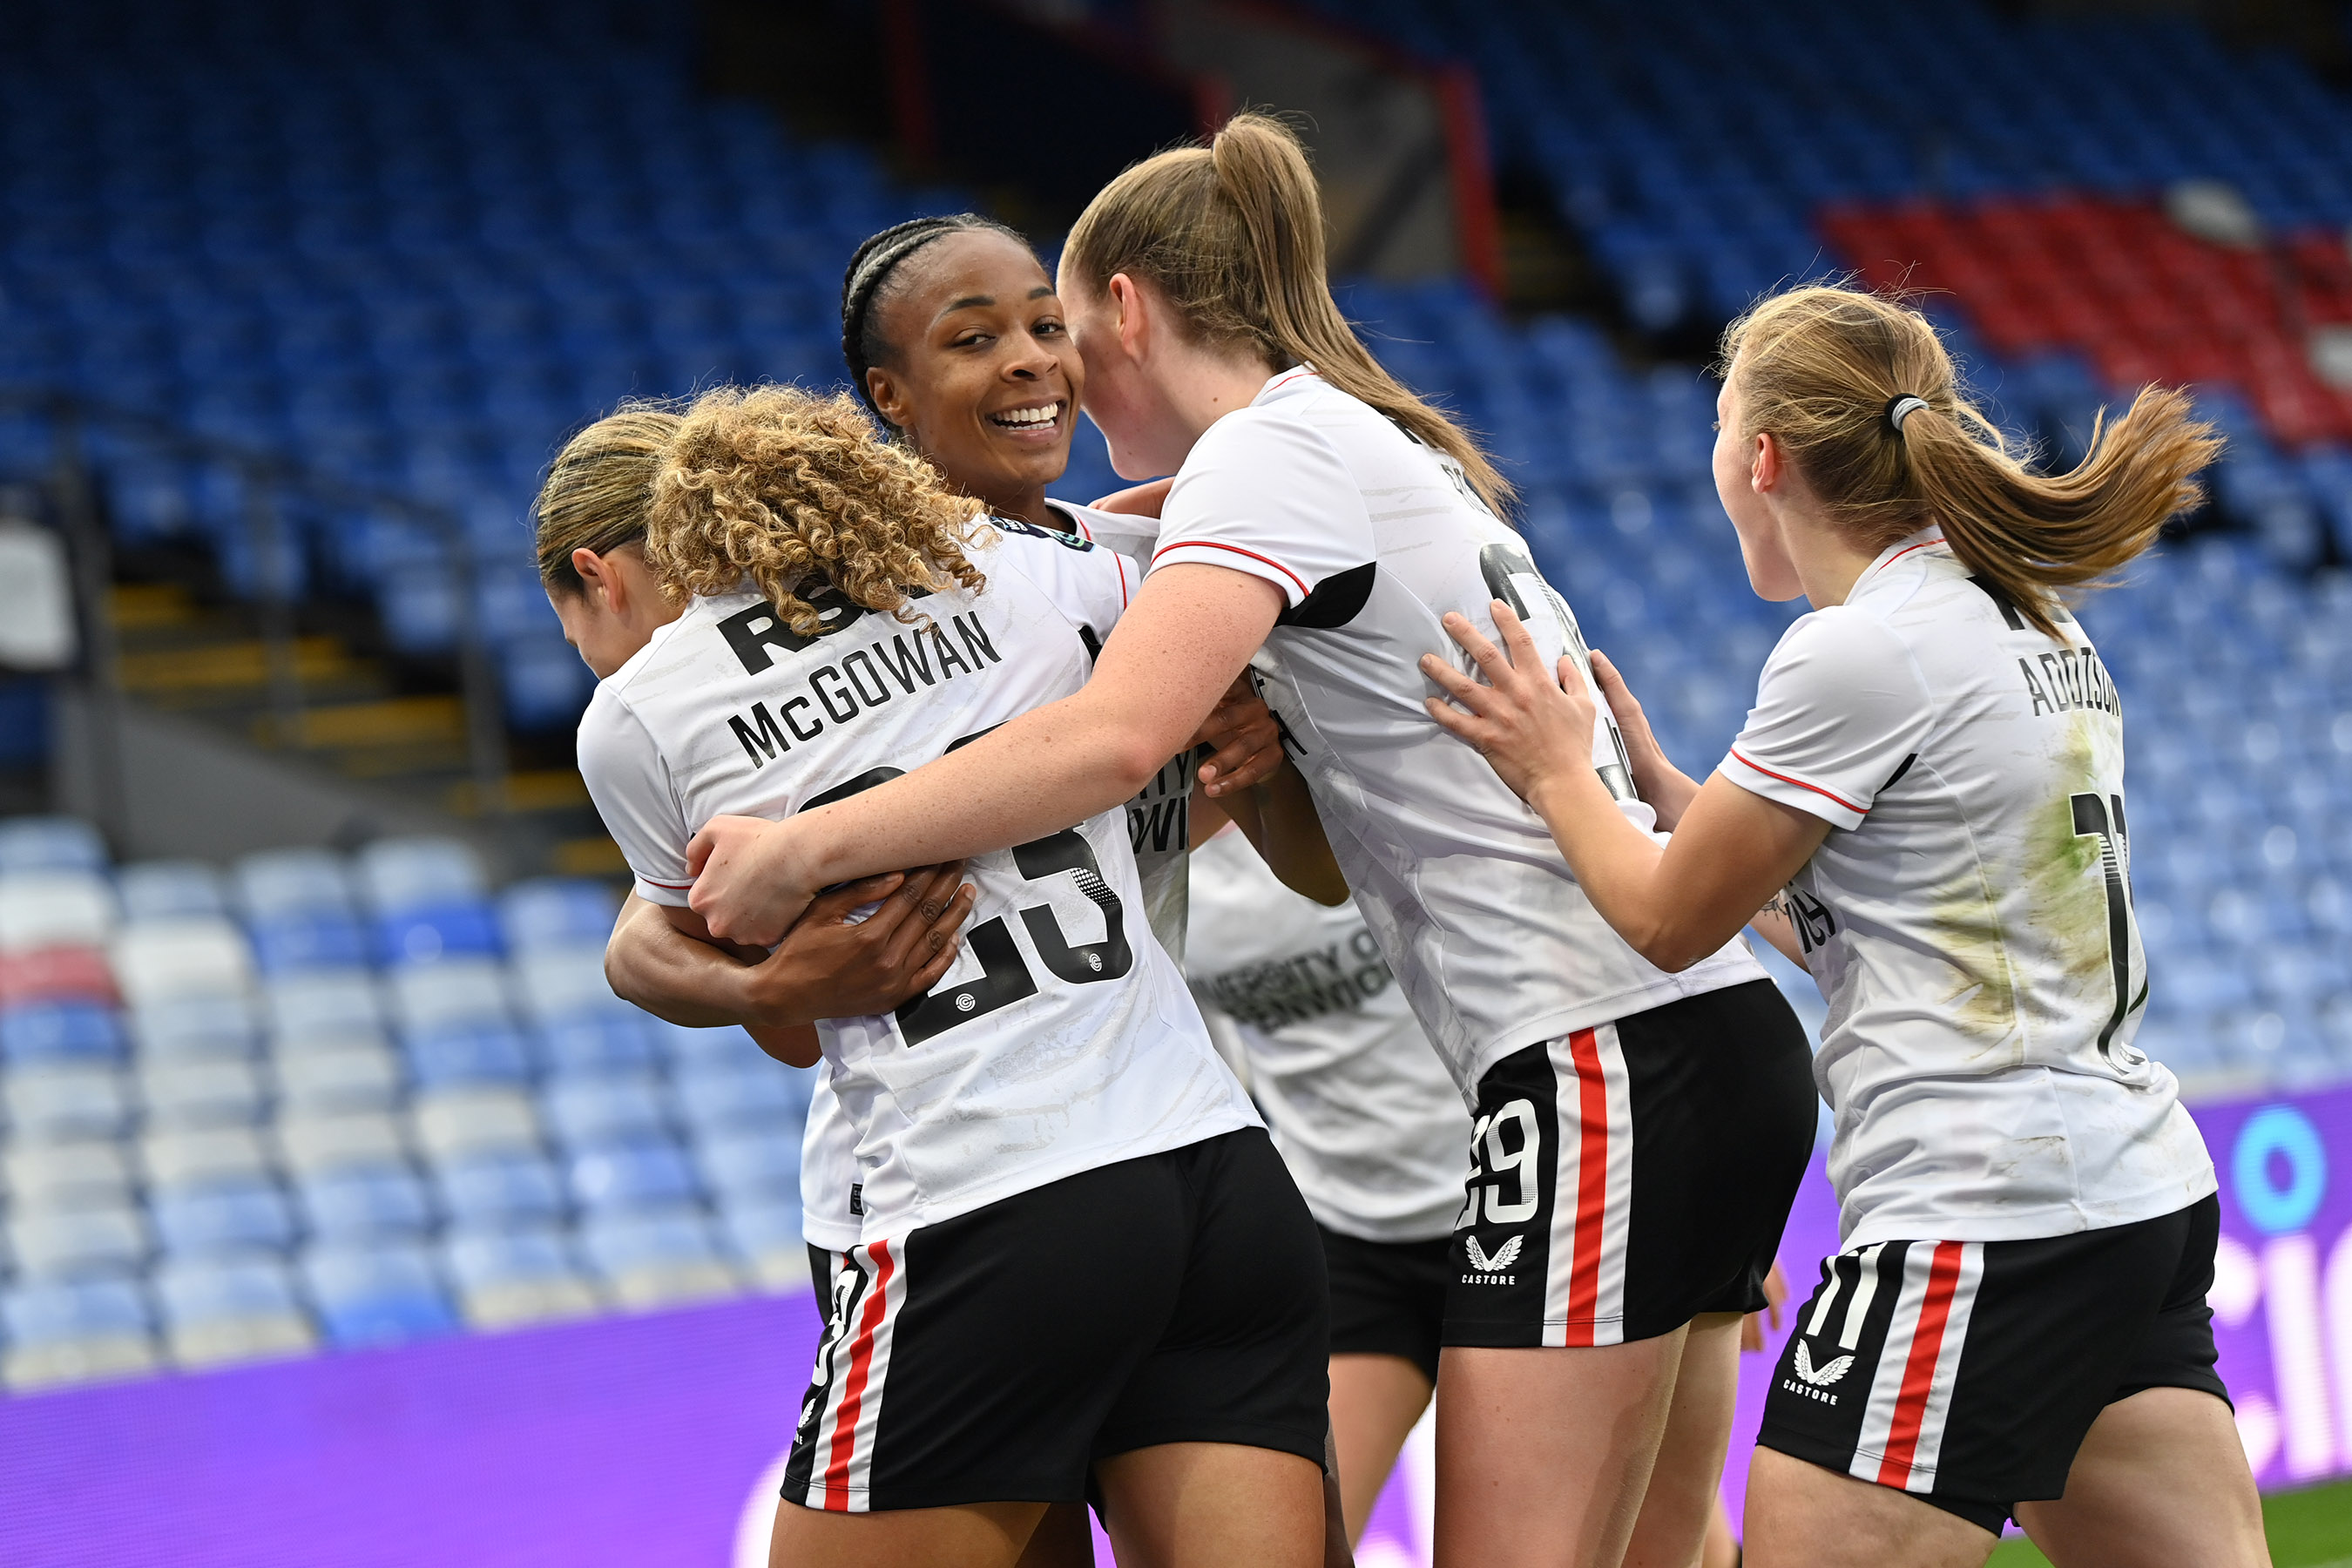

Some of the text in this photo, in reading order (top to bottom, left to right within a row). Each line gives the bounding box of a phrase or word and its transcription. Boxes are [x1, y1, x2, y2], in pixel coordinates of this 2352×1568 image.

[716, 571, 935, 676] RS
[727, 611, 1002, 768] McGOWAN
[1461, 1274, 1516, 1286] CASTORE
[1782, 1379, 1839, 1407] CASTORE
